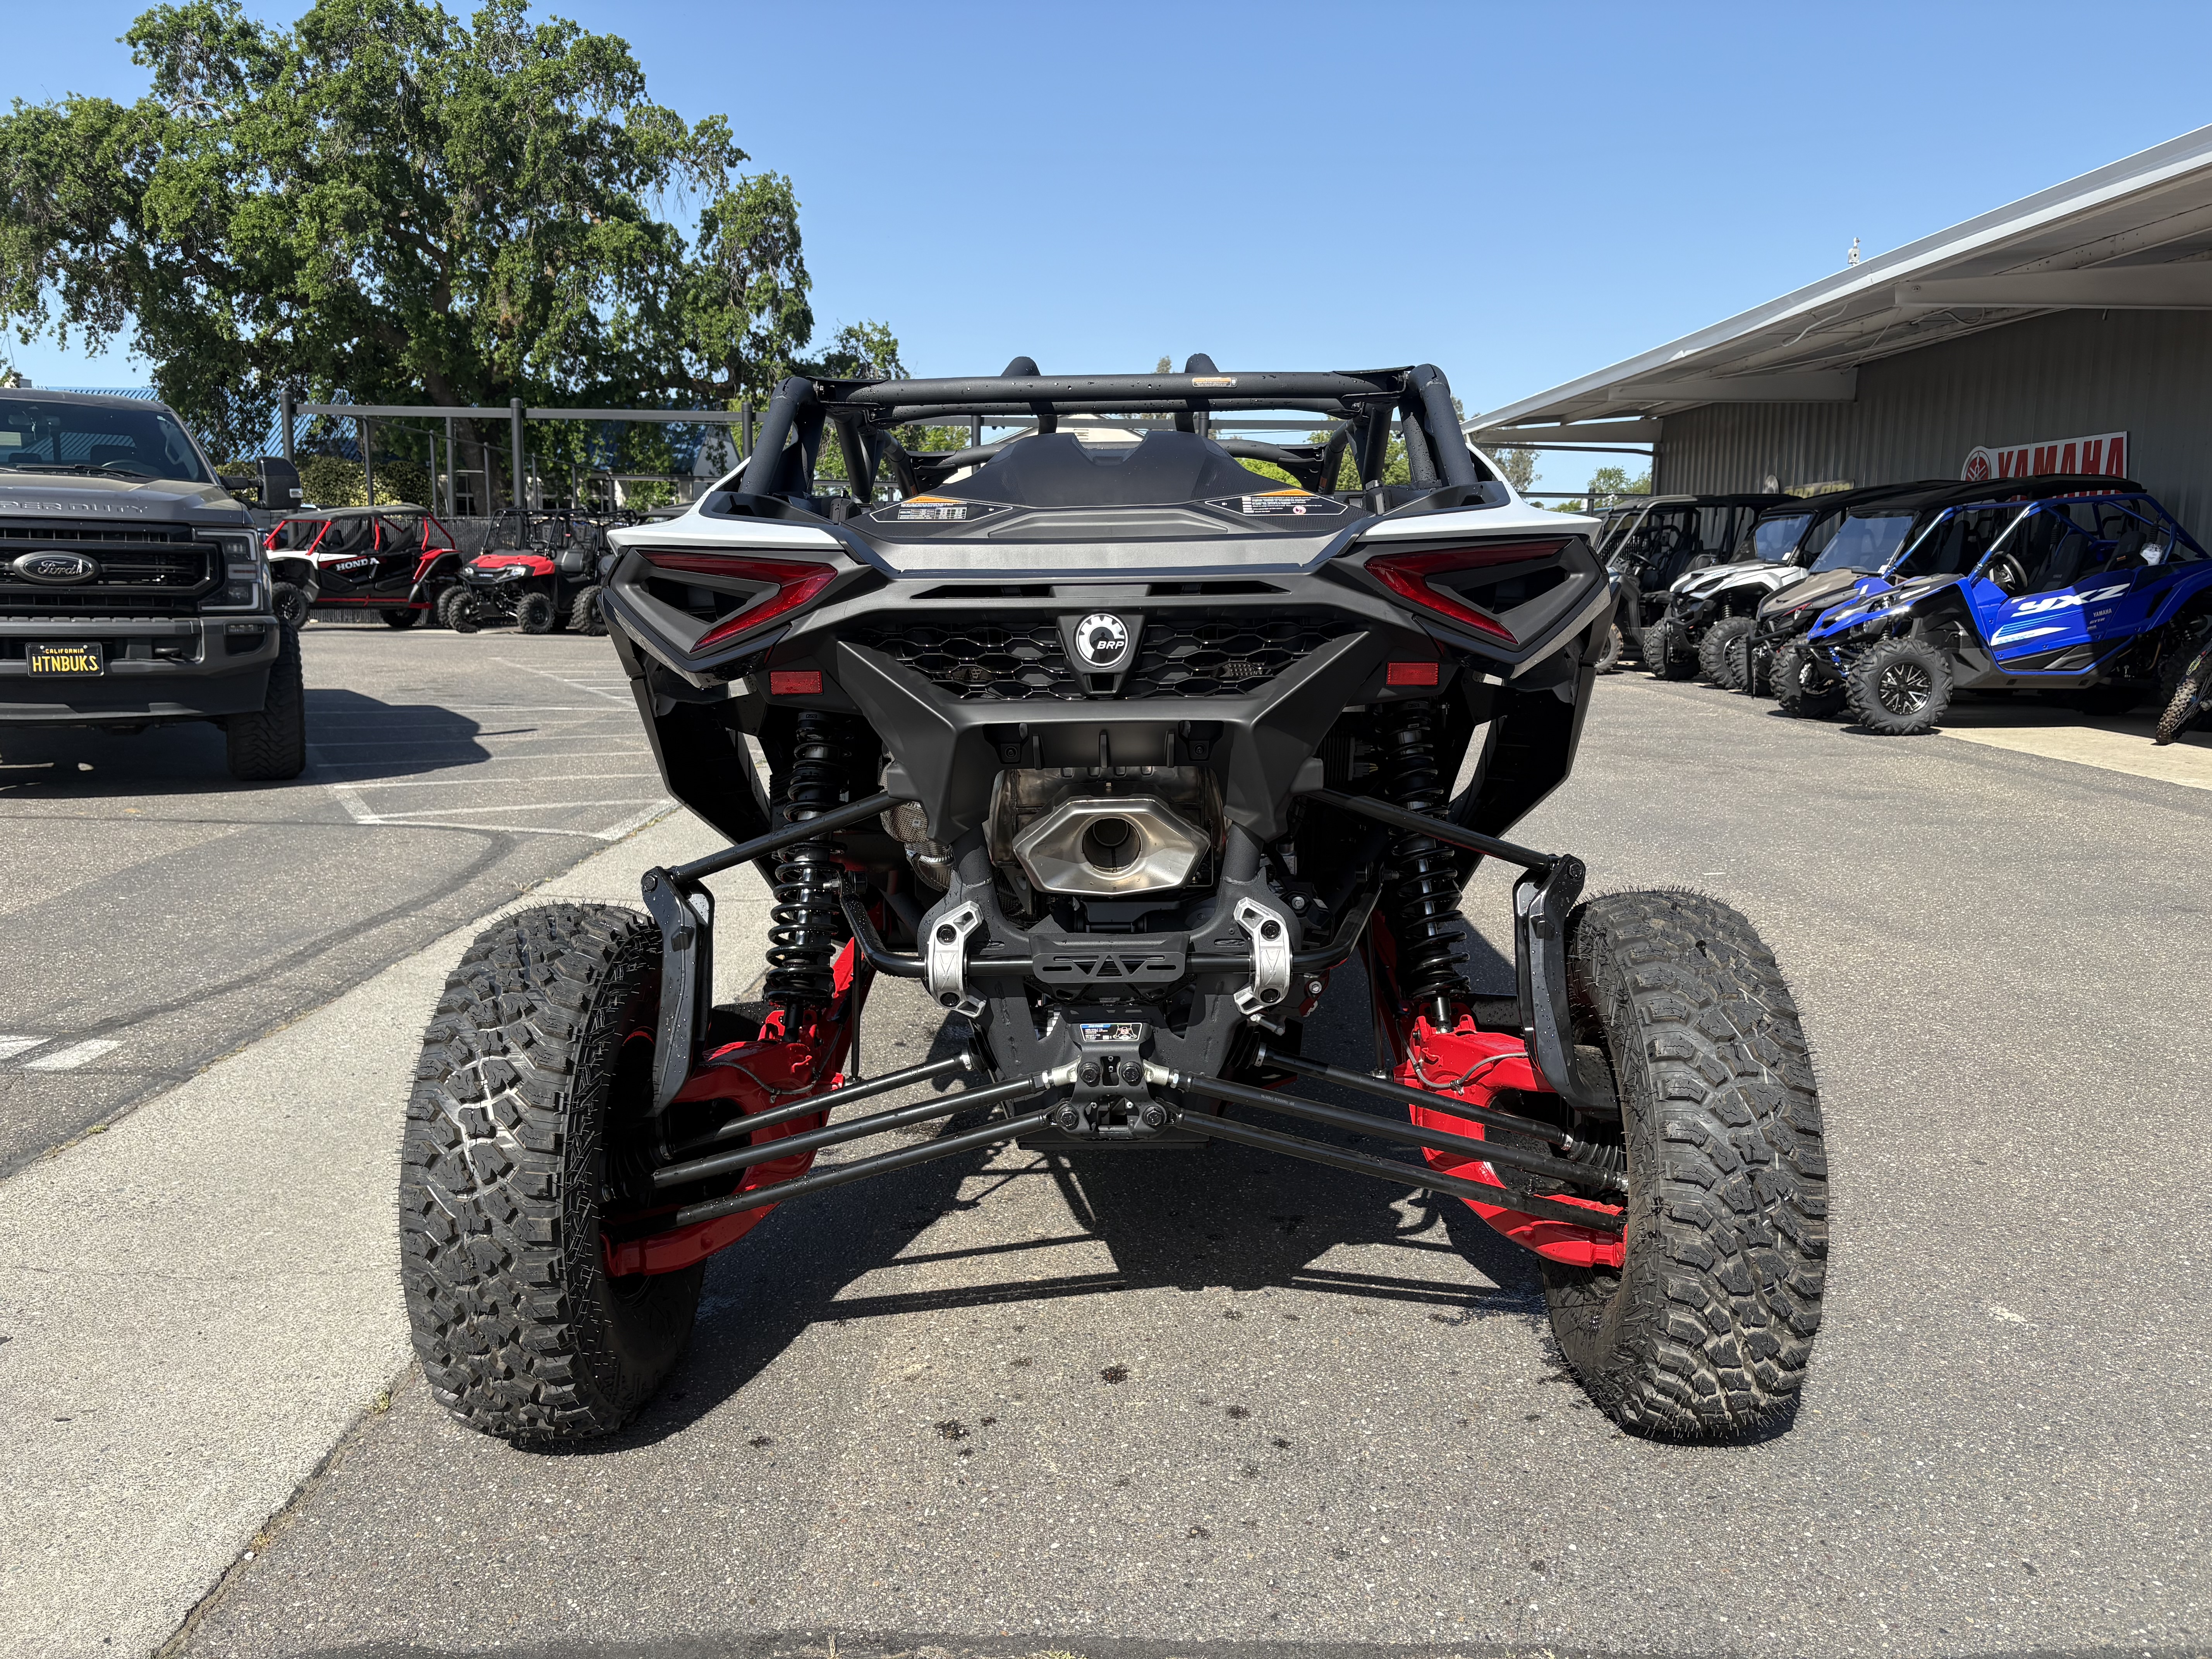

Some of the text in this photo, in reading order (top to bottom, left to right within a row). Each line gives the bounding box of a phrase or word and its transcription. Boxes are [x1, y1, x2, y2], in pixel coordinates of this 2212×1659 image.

[1998, 437, 2124, 500] YAMAHA
[68, 503, 148, 513] DUTY
[38, 560, 82, 576] Ford
[336, 557, 380, 571] HONDA
[2011, 583, 2130, 617] YXZ
[2093, 608, 2112, 617] YAMAHA
[1097, 641, 1124, 649] BRP
[32, 655, 99, 672] HTNBUKS
